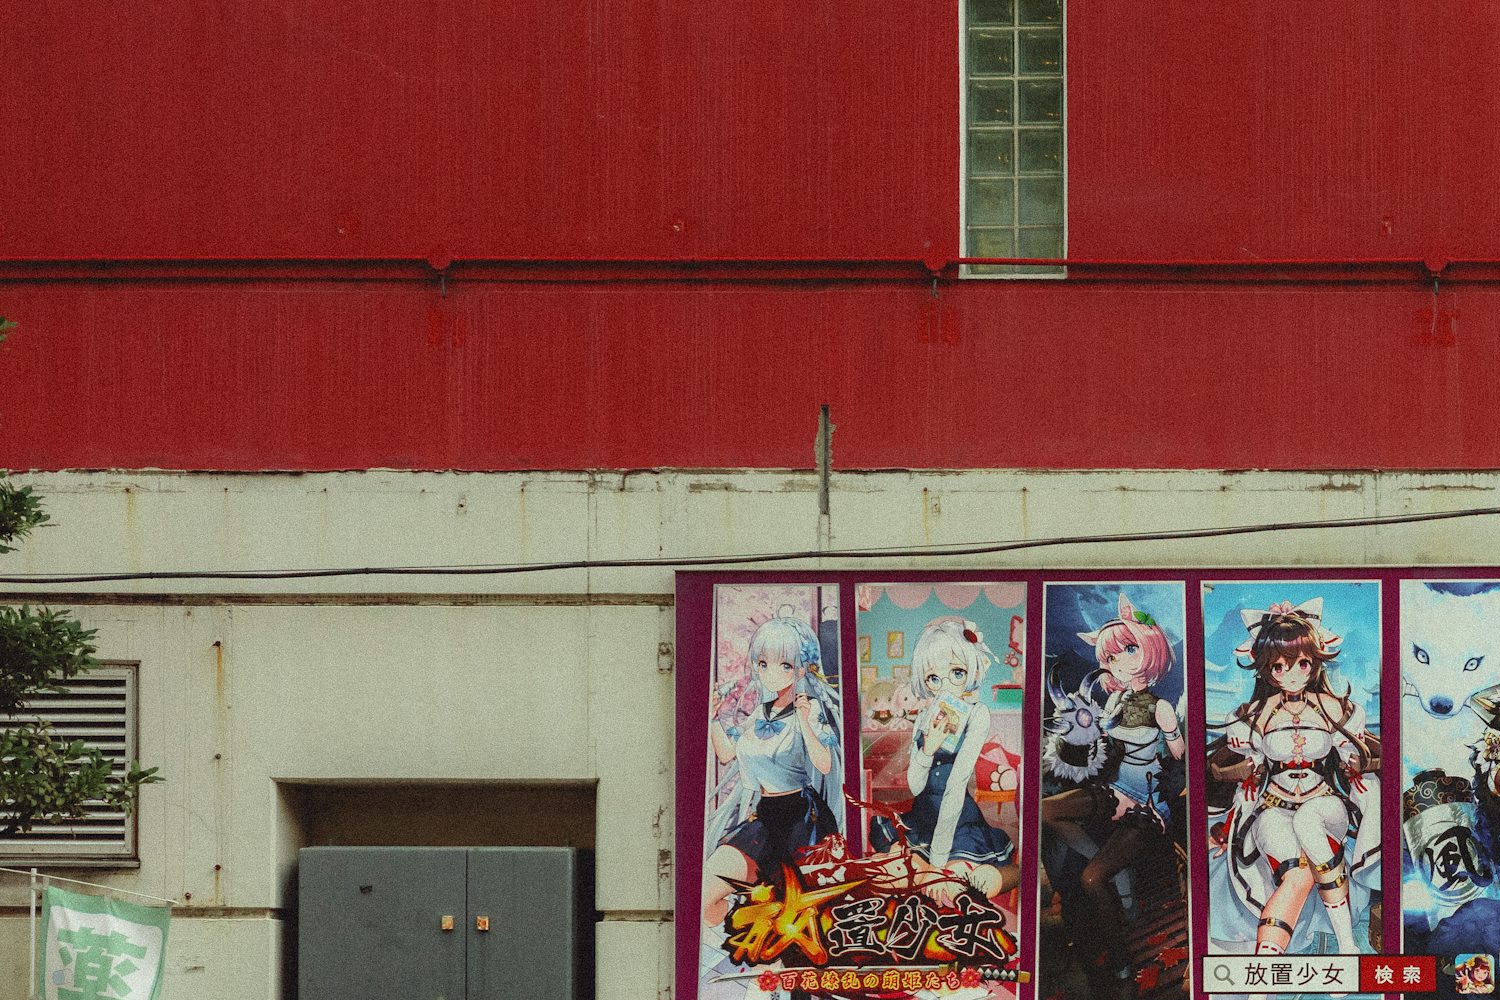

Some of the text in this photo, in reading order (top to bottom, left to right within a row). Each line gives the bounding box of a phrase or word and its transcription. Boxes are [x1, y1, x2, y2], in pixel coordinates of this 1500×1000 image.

[718, 866, 1006, 966] 放置少女
[1244, 962, 1345, 986] 放置少女
[1374, 964, 1422, 985] 検索
